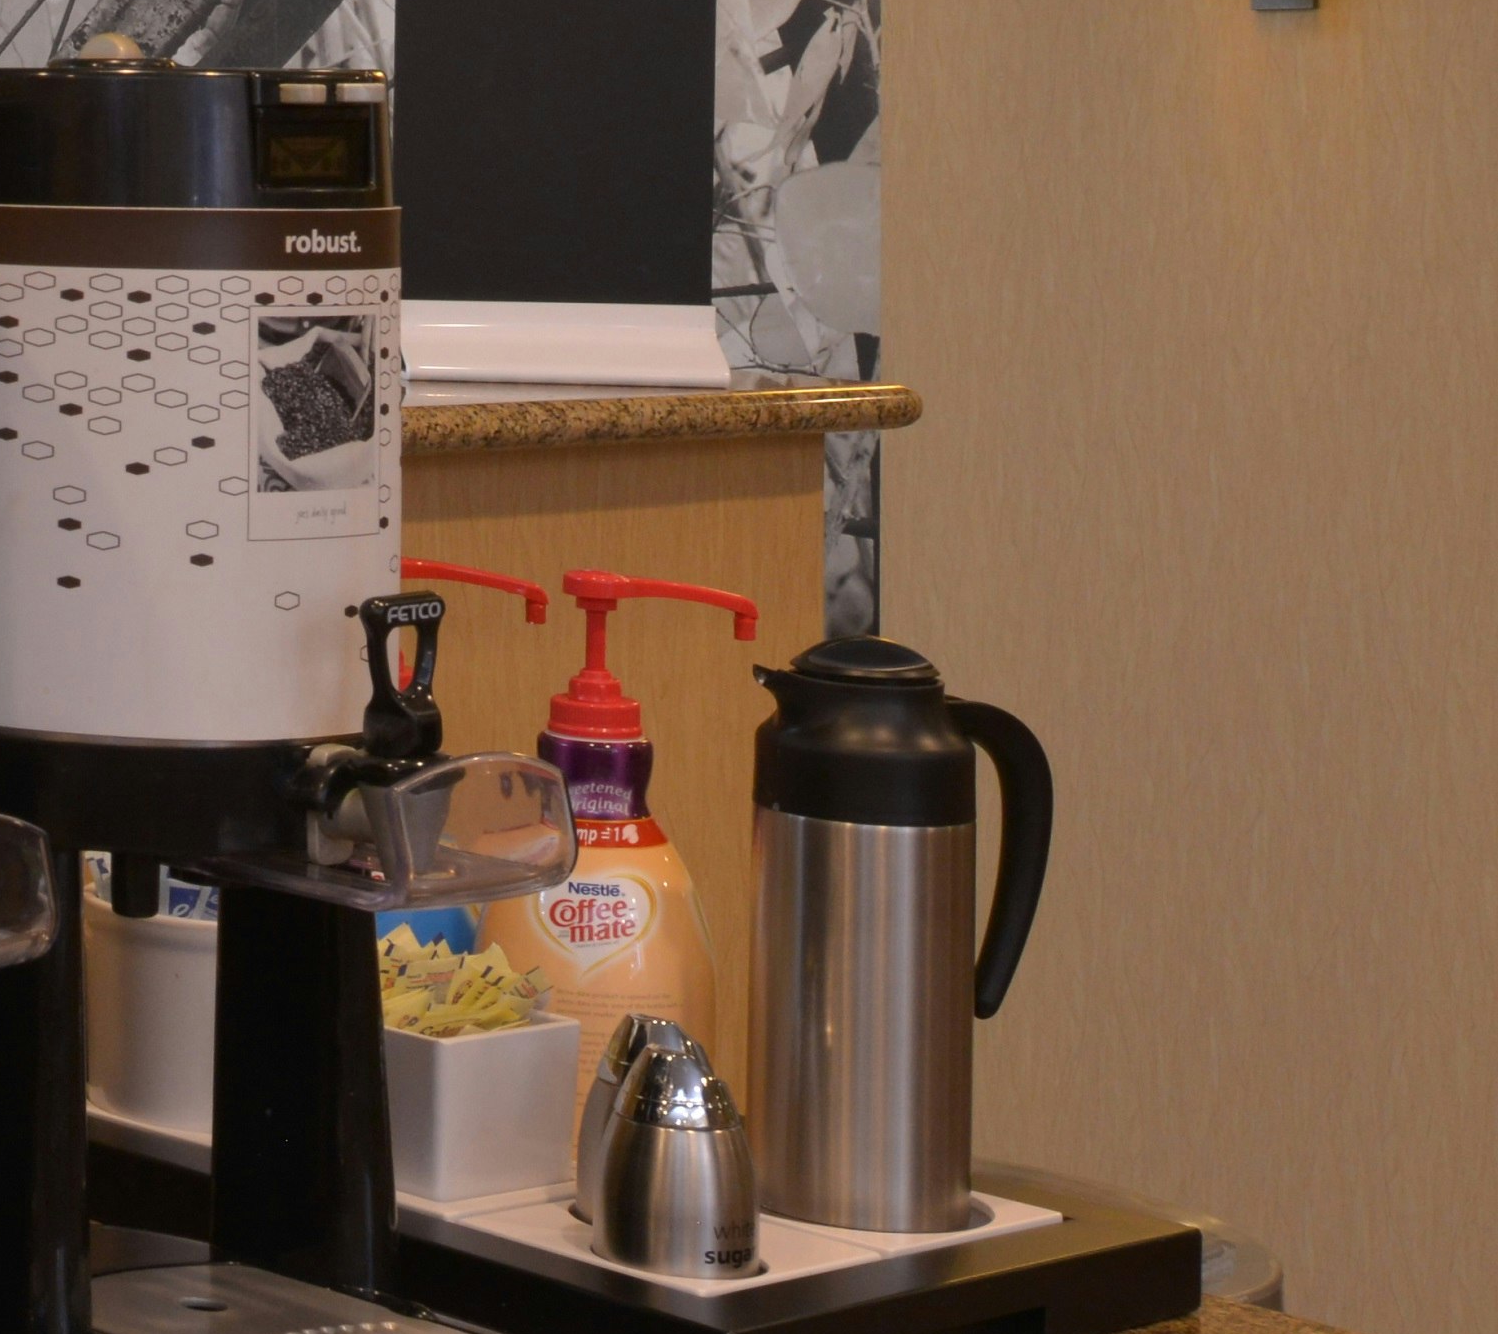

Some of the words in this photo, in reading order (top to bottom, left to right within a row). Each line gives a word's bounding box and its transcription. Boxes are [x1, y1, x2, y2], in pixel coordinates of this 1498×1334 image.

[285, 229, 362, 254] robust.
[387, 601, 442, 624] FETCO
[704, 1248, 753, 1269] suga
